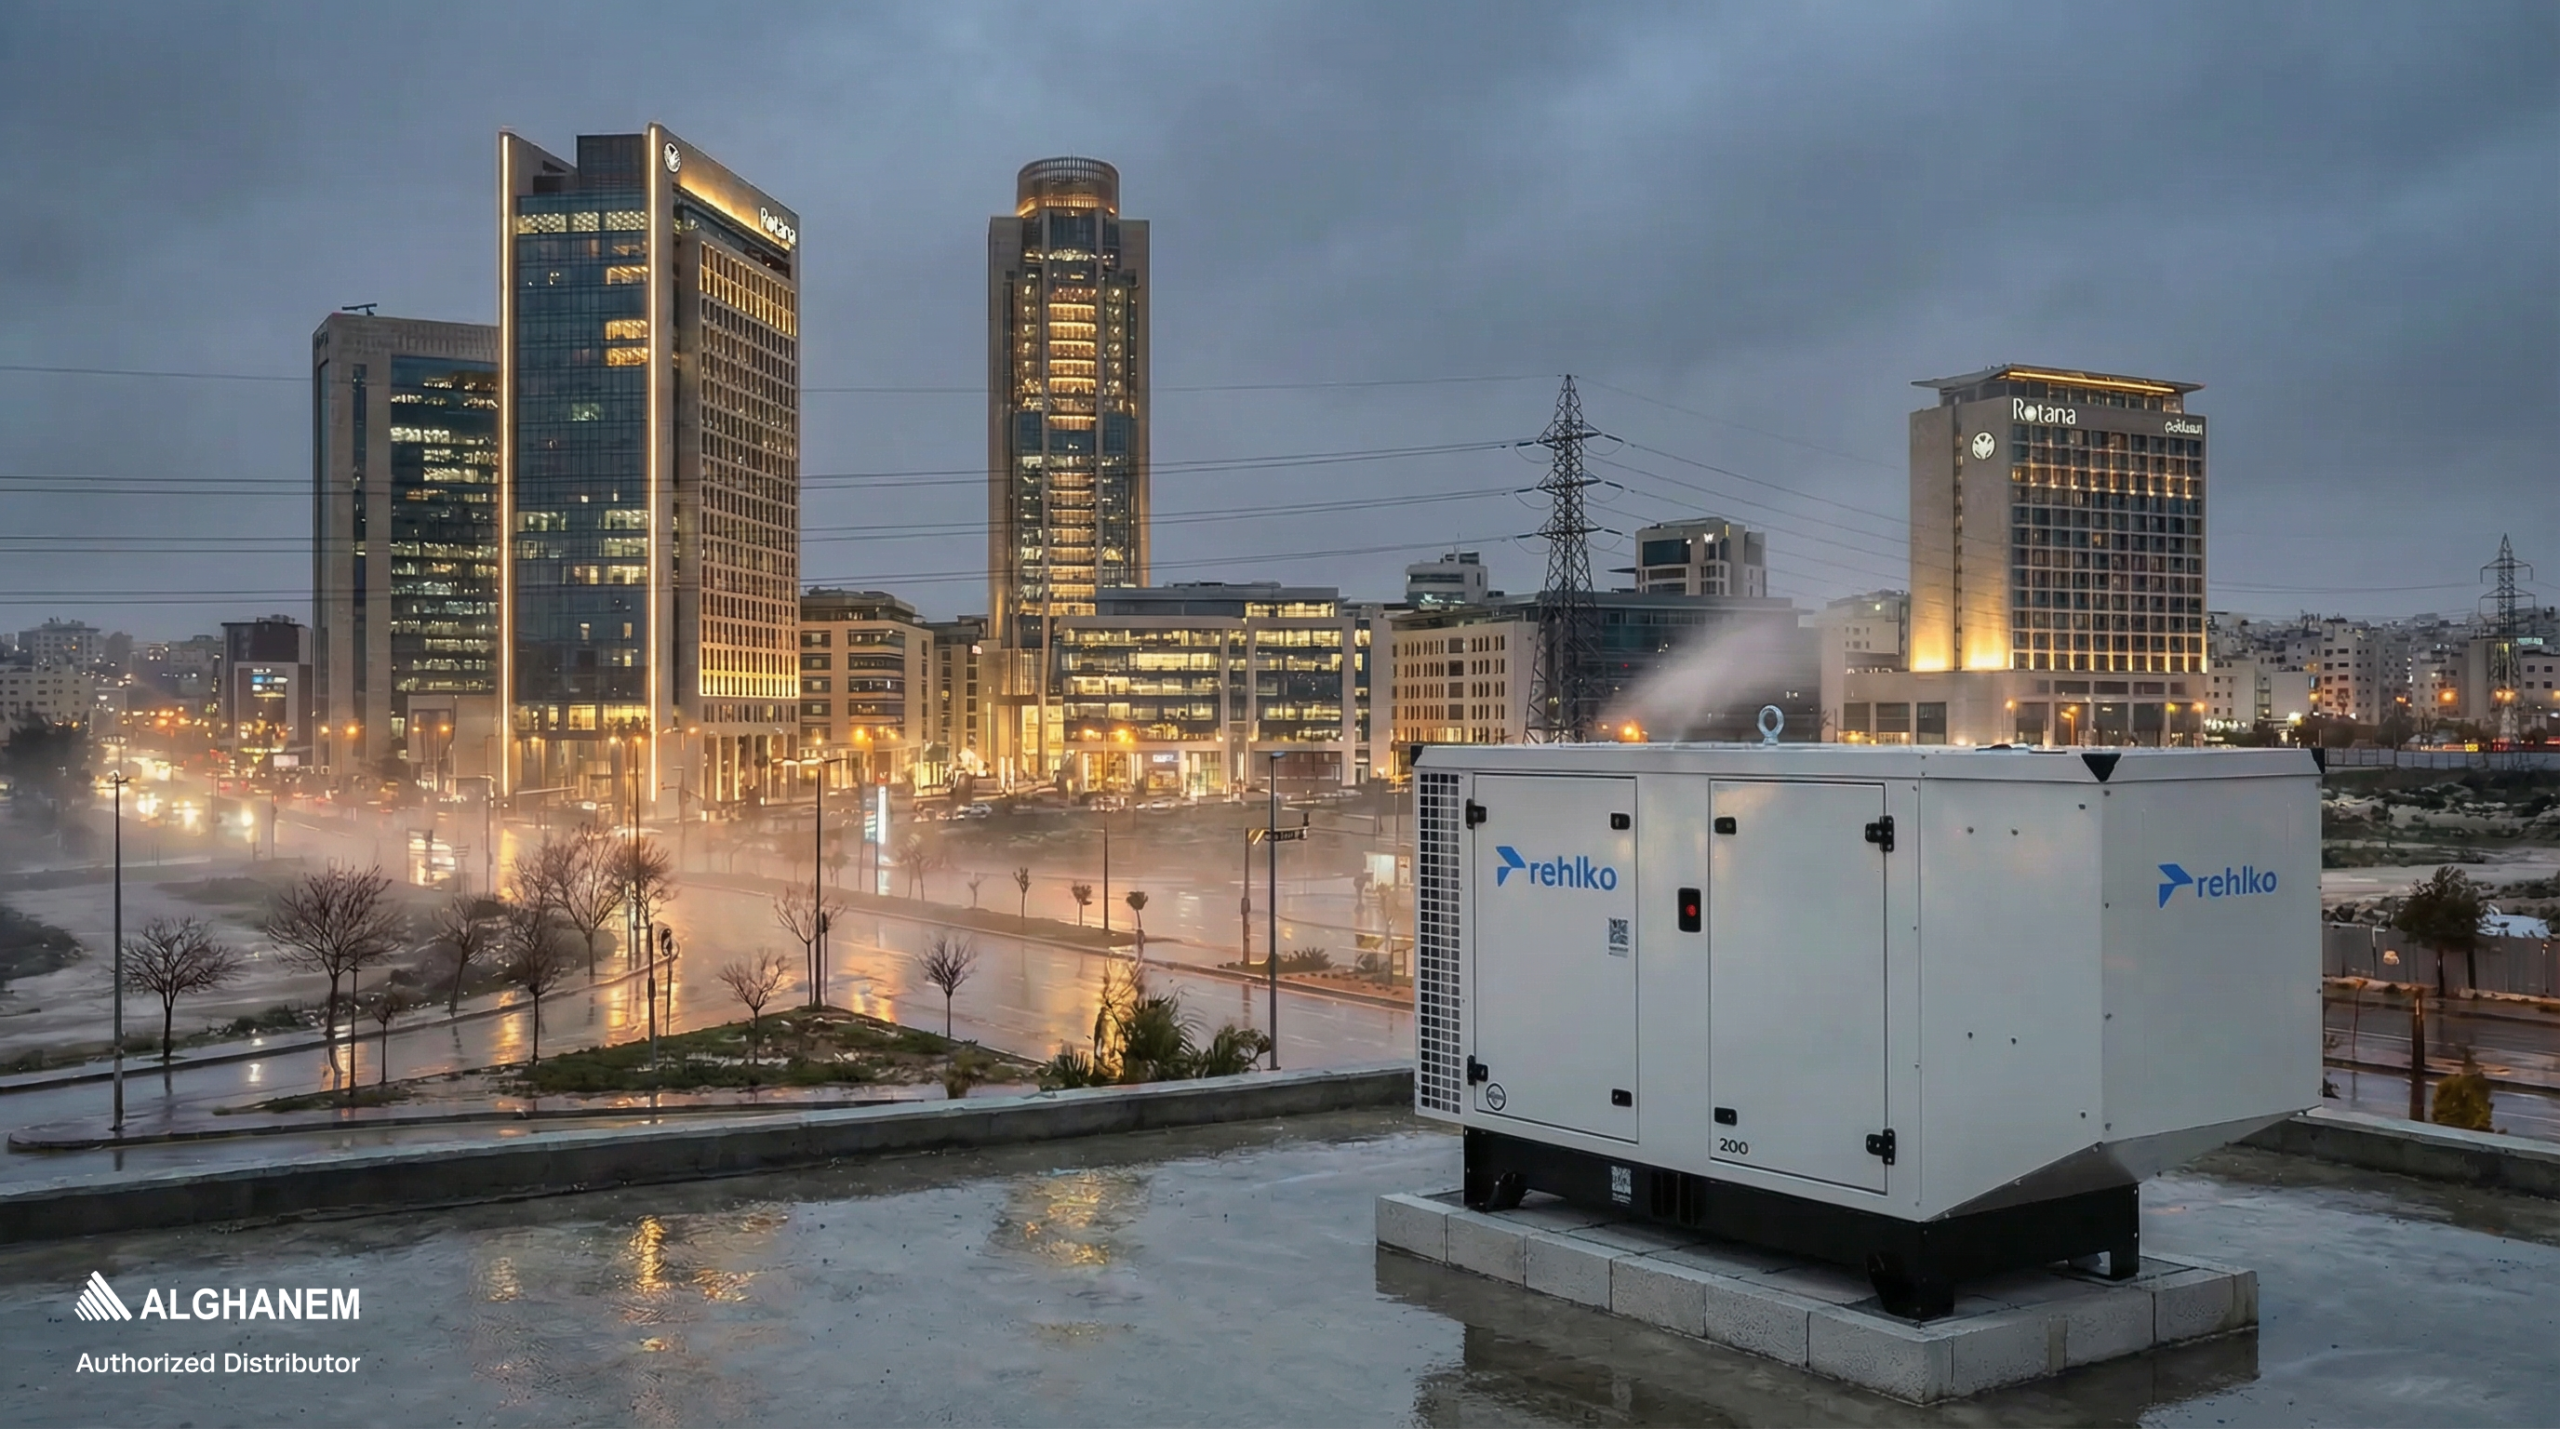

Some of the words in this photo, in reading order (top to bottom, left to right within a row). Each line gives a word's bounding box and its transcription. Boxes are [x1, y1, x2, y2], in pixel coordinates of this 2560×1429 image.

[2013, 397, 2076, 425] Rotana
[1529, 855, 1618, 891] rehlko
[2197, 865, 2278, 898] rehlko
[1719, 1137, 1749, 1156] 200
